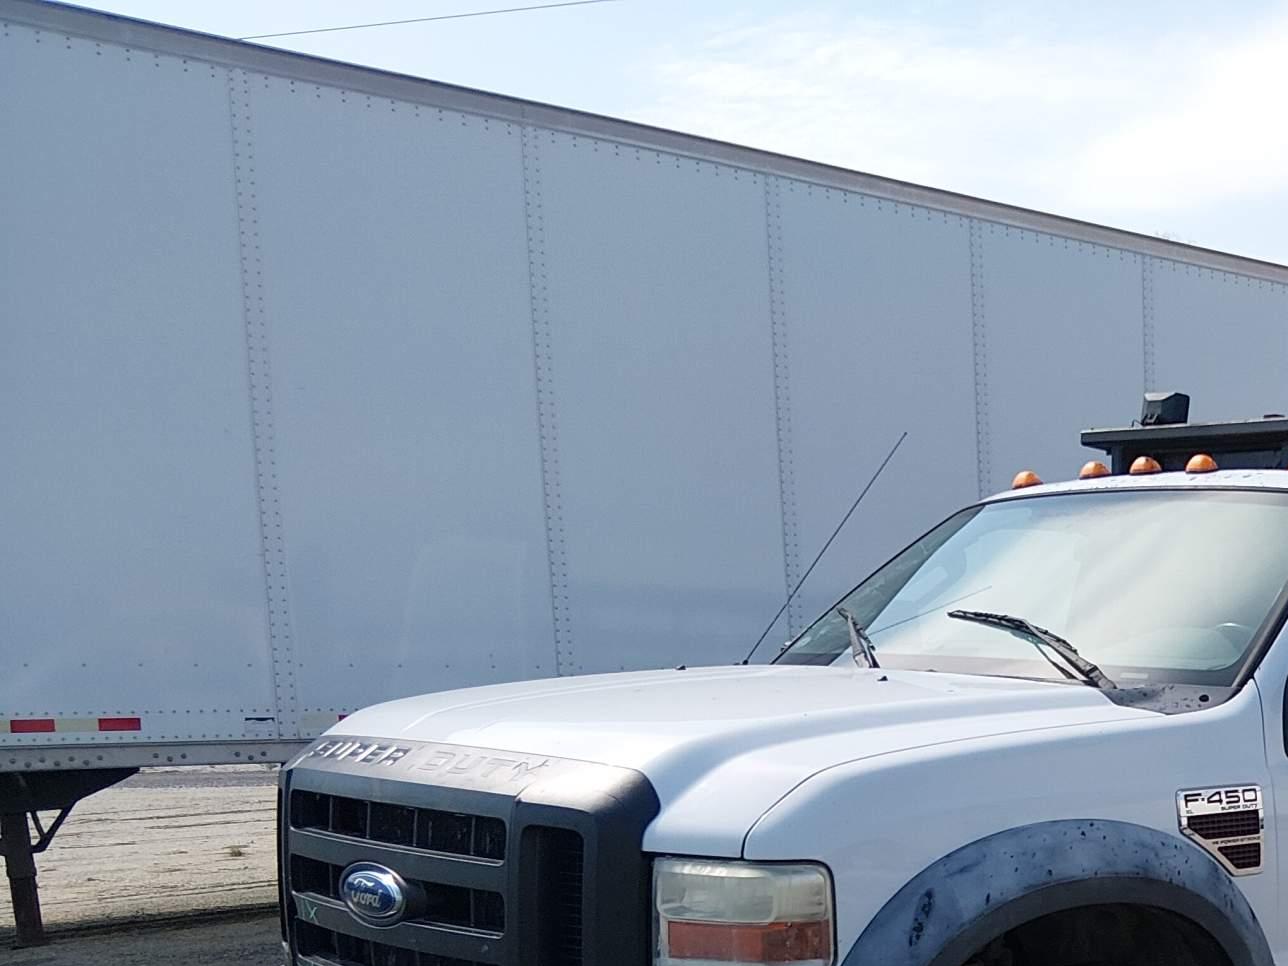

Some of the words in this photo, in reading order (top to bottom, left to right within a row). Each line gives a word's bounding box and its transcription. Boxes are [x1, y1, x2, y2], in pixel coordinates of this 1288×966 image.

[309, 741, 411, 767] SUPER
[415, 749, 549, 782] DUTY
[1184, 788, 1258, 809] F-450
[351, 878, 384, 908] Ford
